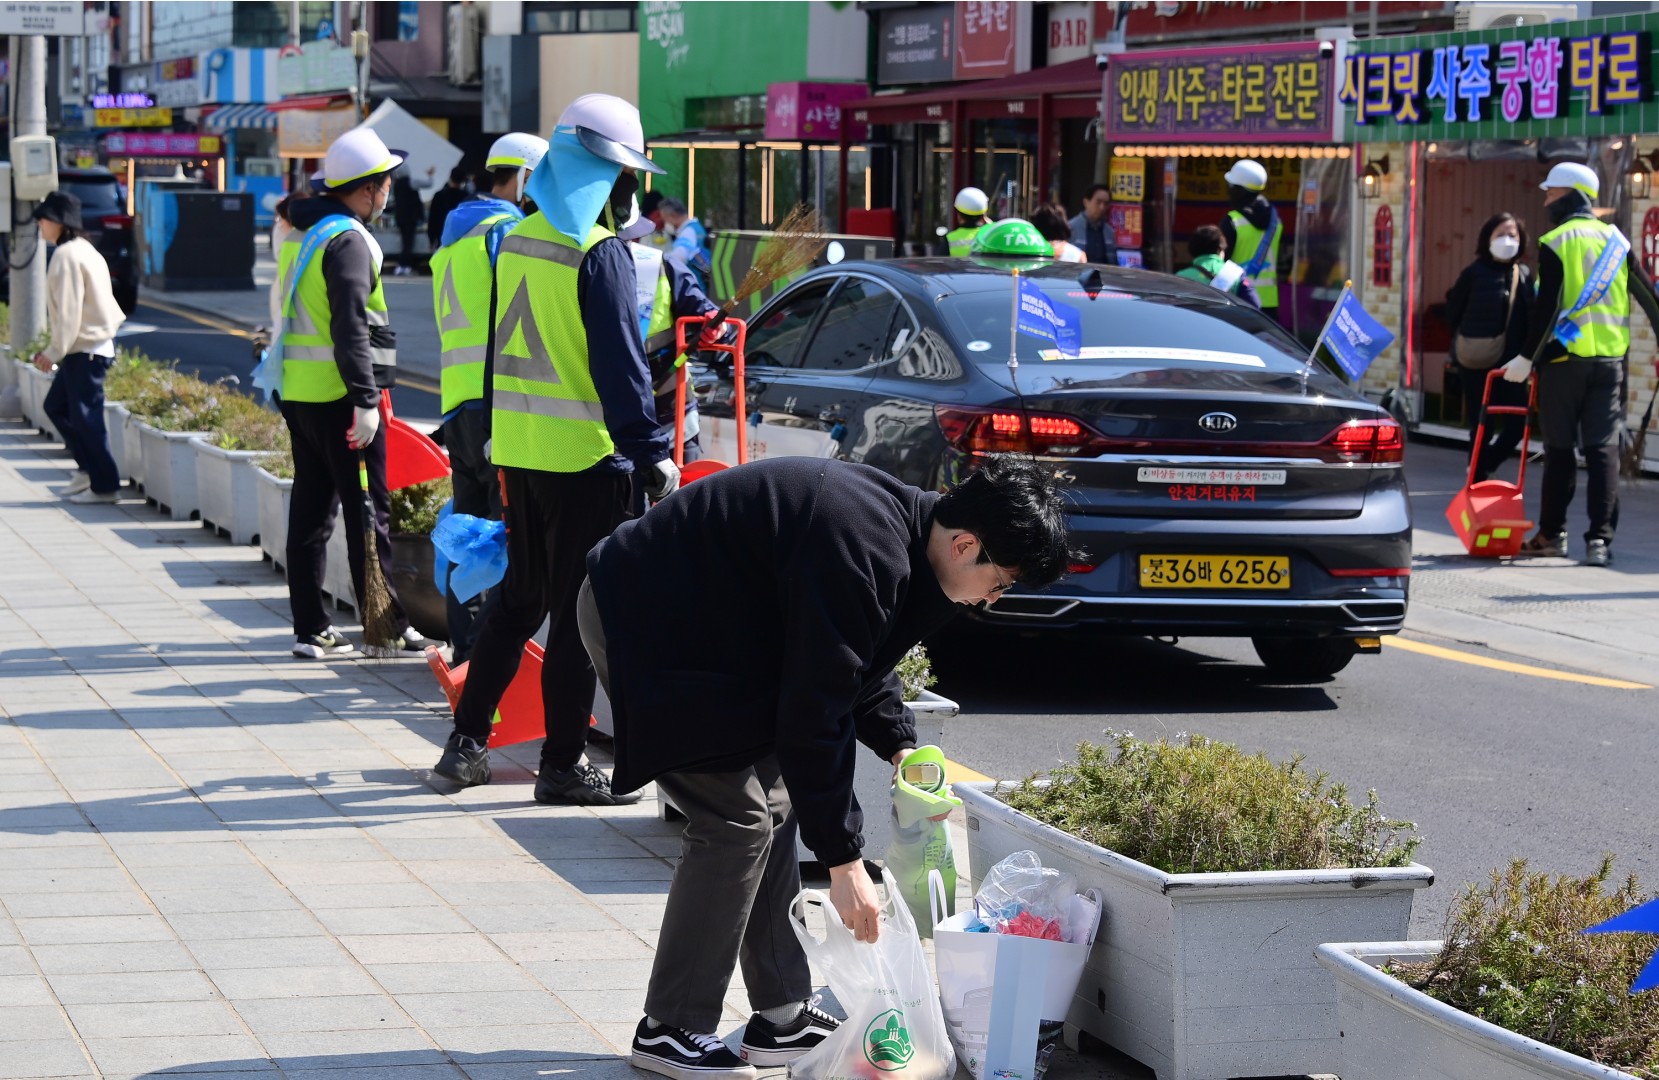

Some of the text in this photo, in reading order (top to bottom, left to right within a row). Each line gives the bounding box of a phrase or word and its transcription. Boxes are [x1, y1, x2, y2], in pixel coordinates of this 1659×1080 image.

[647, 11, 684, 48] BUSAN
[1050, 18, 1087, 48] BAR
[1119, 68, 1159, 123] 인생
[1271, 62, 1319, 120] 전문
[1339, 32, 1641, 125] 시크릿 사주 궁합 타로
[1022, 293, 1043, 309] WORLD
[1206, 416, 1232, 429] KIA
[1219, 559, 1281, 584] 6256
